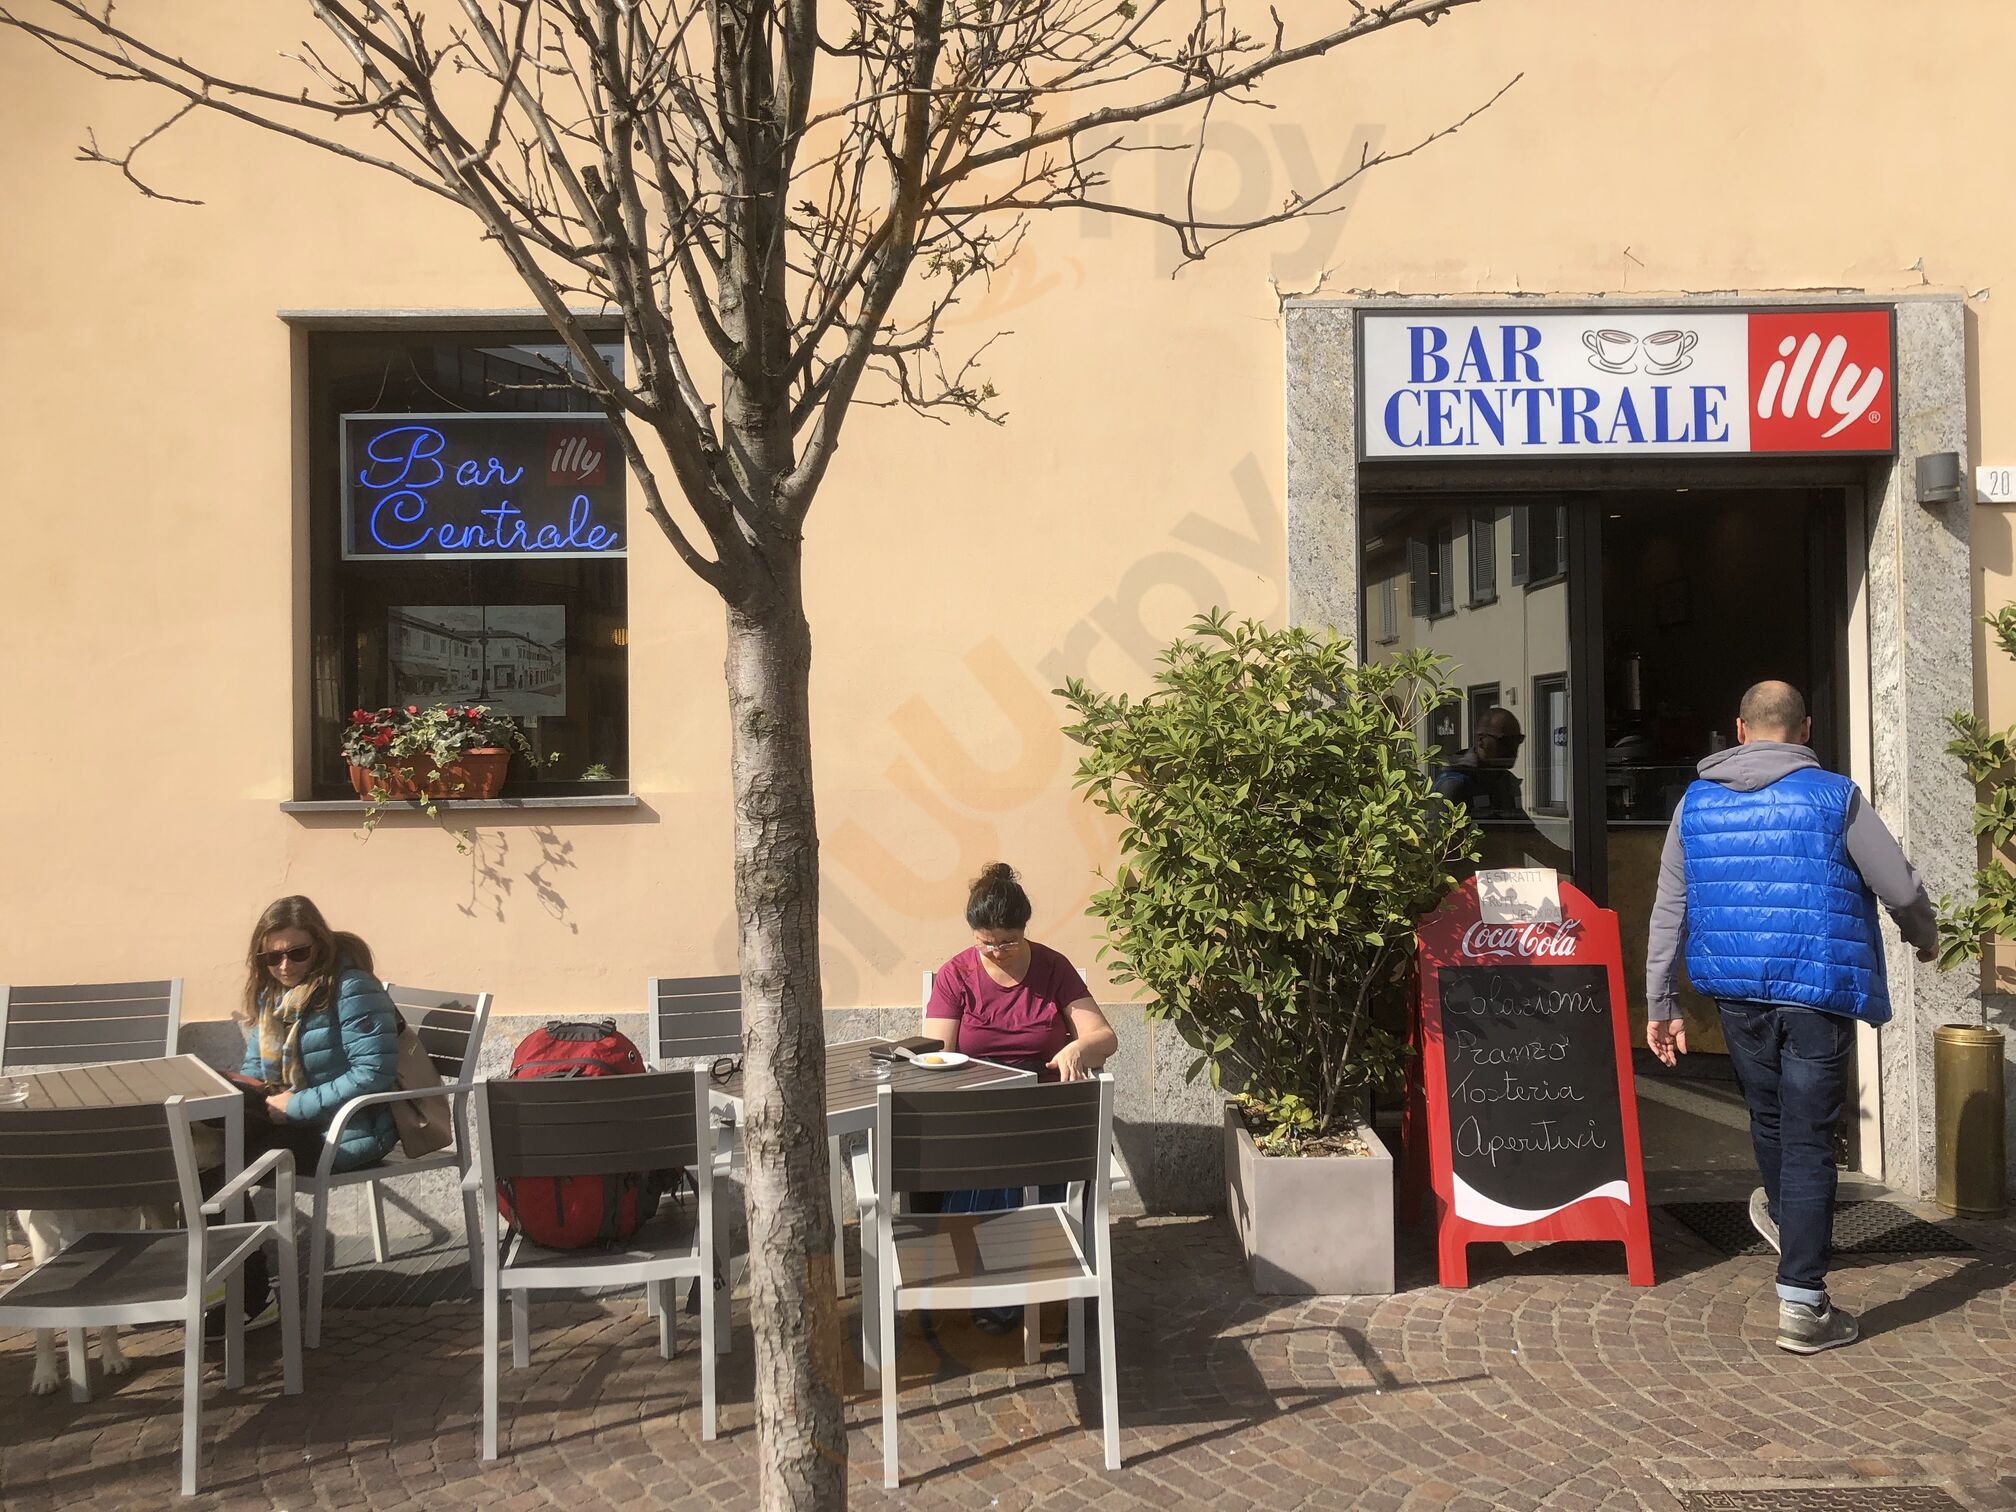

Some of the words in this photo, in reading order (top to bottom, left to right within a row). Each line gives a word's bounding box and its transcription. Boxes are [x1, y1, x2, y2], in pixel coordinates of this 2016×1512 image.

[1406, 325, 1544, 384] BAR
[1757, 332, 1885, 439] illy
[1383, 385, 1730, 448] CENTRALE
[360, 426, 524, 489] Bar
[551, 436, 602, 481] illy
[1990, 470, 2010, 496] 20
[370, 490, 618, 551] Centrale
[1461, 918, 1582, 958] Coca-Cola
[1444, 975, 1603, 1017] Colazioni
[1453, 1029, 1570, 1065] Pranzo
[1451, 1068, 1585, 1103] Tosteria
